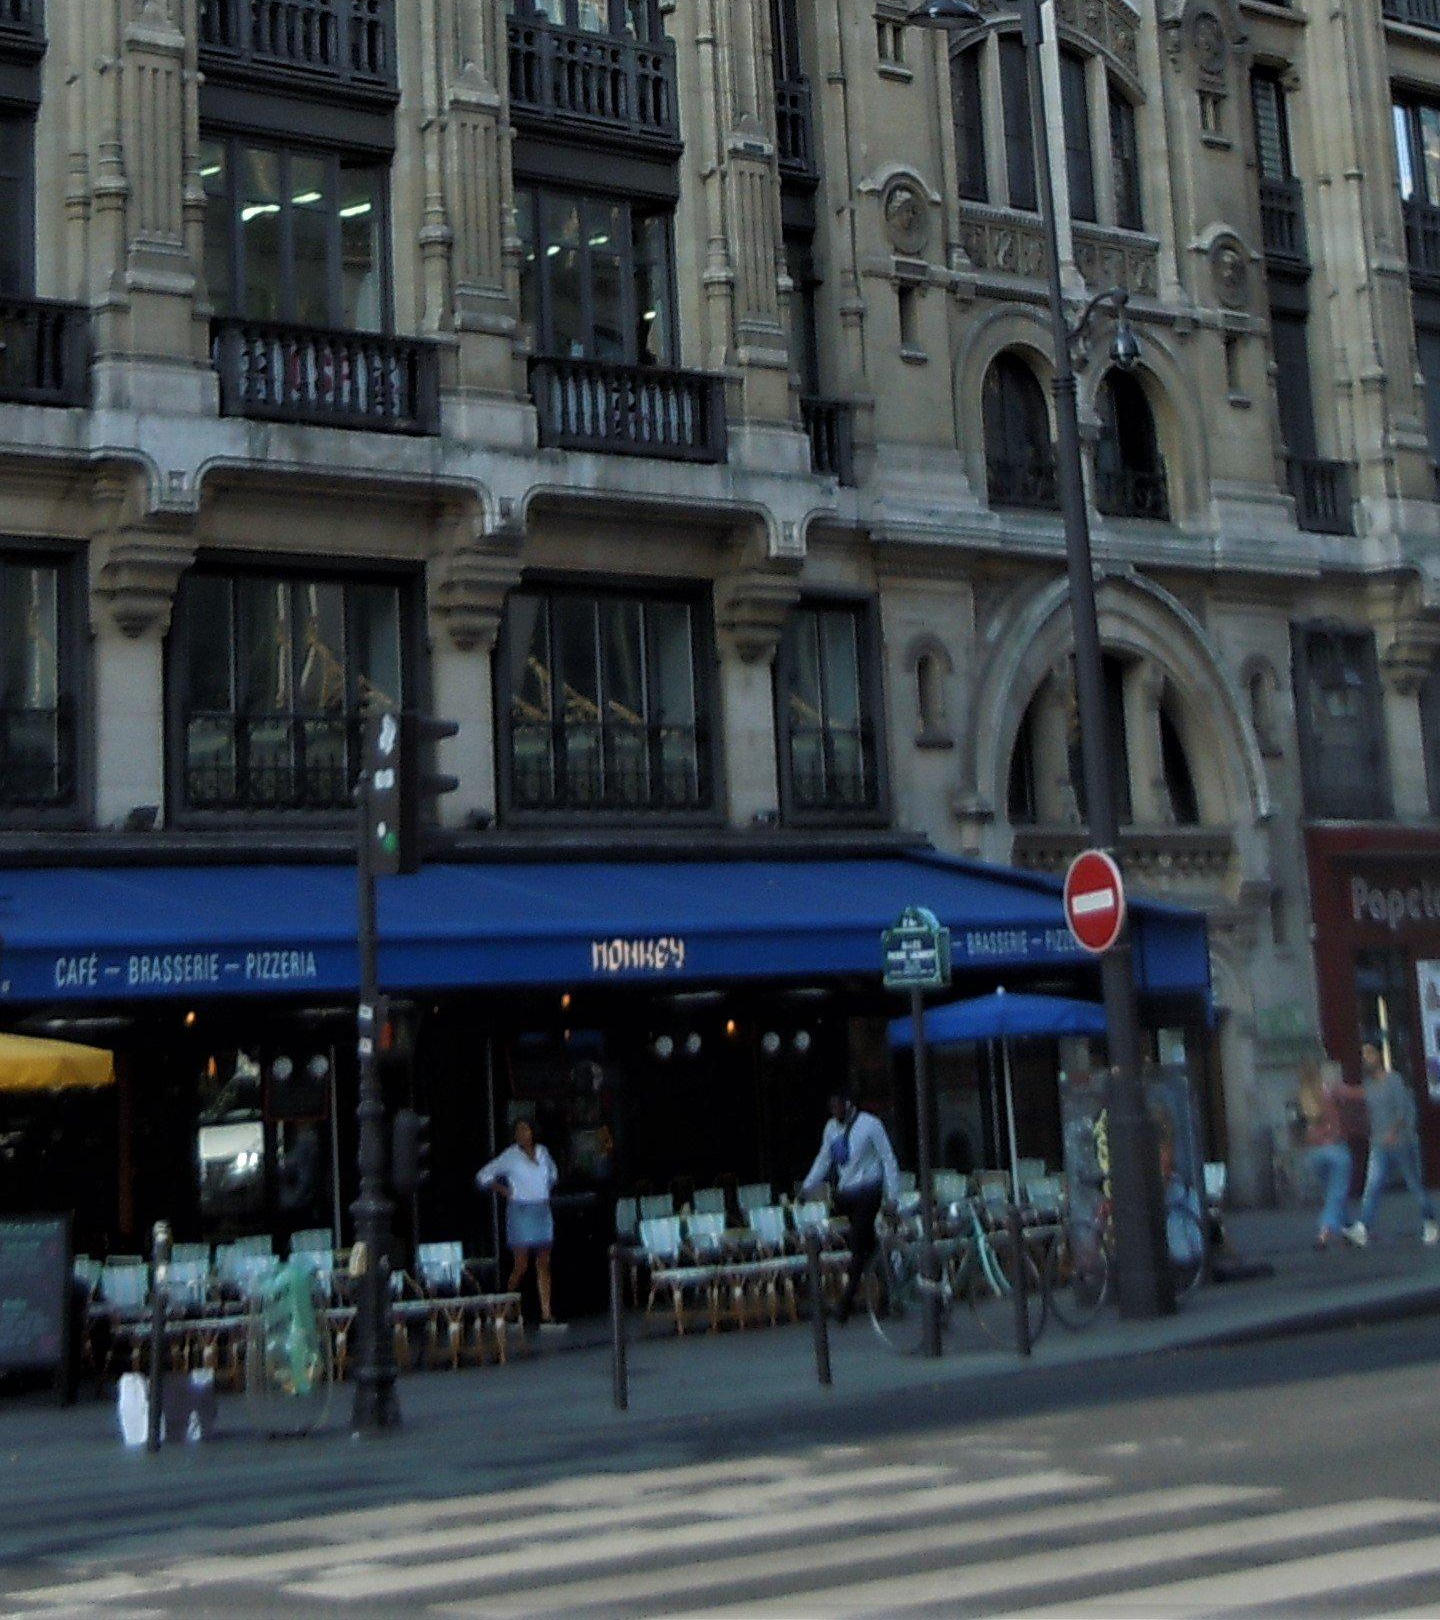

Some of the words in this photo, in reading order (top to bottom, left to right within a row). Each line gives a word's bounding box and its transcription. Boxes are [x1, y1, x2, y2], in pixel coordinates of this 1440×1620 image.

[54, 952, 100, 987] CAFÉ
[126, 952, 220, 985] BRASSERIE
[245, 949, 317, 980] PIZZERIA
[591, 937, 685, 972] MONKEY
[967, 931, 1029, 956] BRASSERIE
